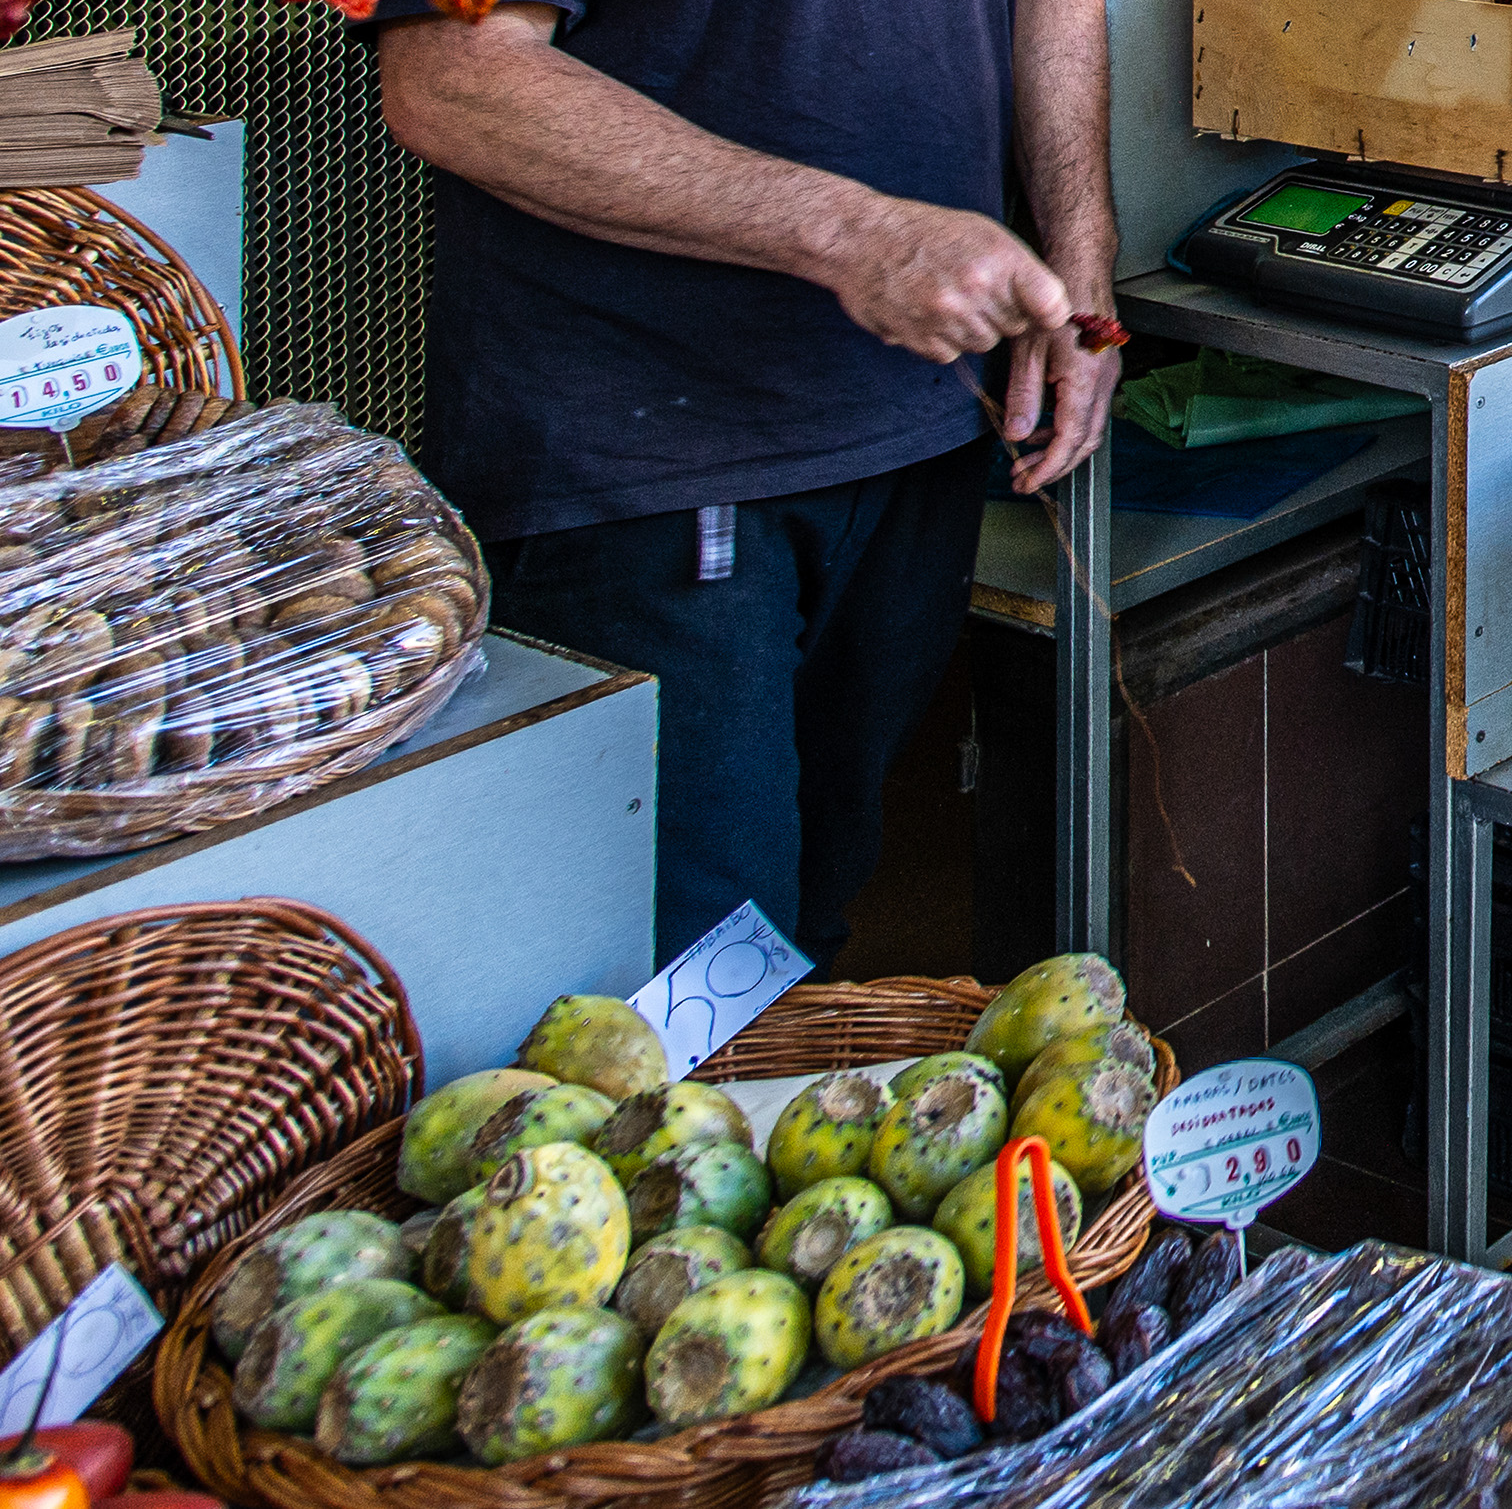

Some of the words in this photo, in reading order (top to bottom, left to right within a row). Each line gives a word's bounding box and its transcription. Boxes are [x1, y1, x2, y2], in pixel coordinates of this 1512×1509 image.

[1461, 216, 1475, 225] 7
[1478, 219, 1491, 228] 8
[1498, 223, 1509, 232] 9
[1443, 230, 1455, 240] 4
[1460, 234, 1474, 243] 5
[1478, 237, 1491, 246] 6
[1299, 241, 1328, 253] DIBAL
[1426, 245, 1437, 254] 1
[1441, 248, 1453, 258] 2
[1459, 252, 1472, 261] 3
[1404, 259, 1418, 269] 0
[1419, 262, 1439, 273] 00
[1226, 1137, 1302, 1185] 2,90
